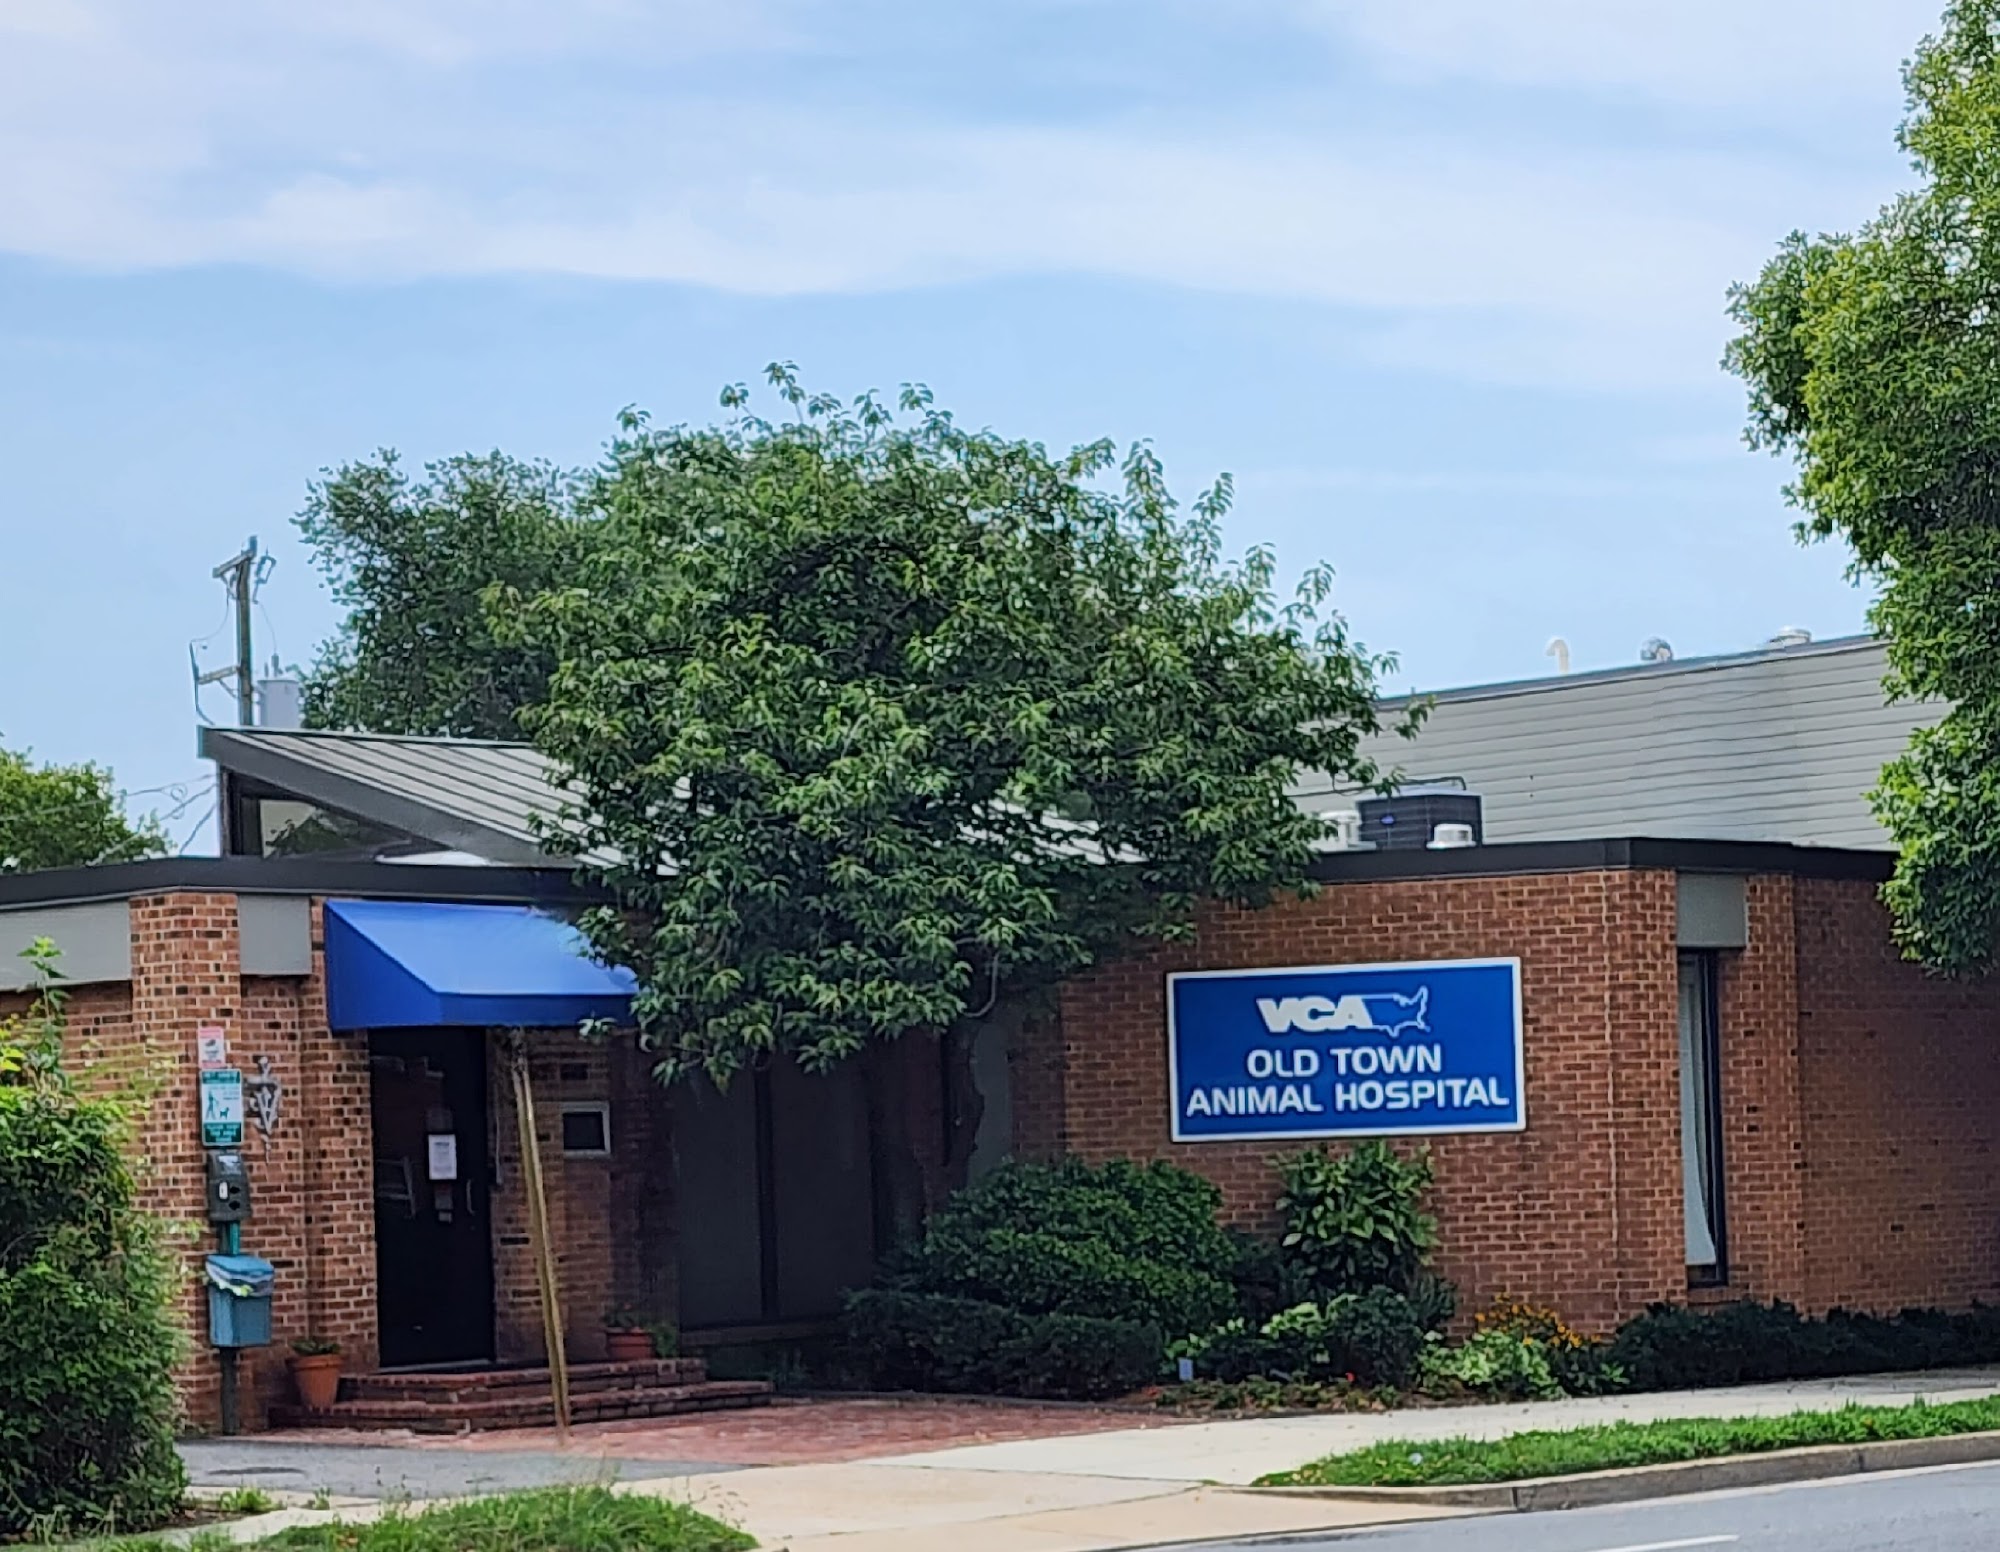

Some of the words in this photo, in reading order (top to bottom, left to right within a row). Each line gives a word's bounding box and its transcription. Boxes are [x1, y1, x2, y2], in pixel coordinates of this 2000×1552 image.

[1256, 994, 1374, 1033] VCA
[1247, 1049, 1319, 1078] OLD
[1330, 1043, 1442, 1075] TOWN
[1186, 1084, 1324, 1117] ANIMAL
[1335, 1076, 1510, 1112] HOSPITAL
